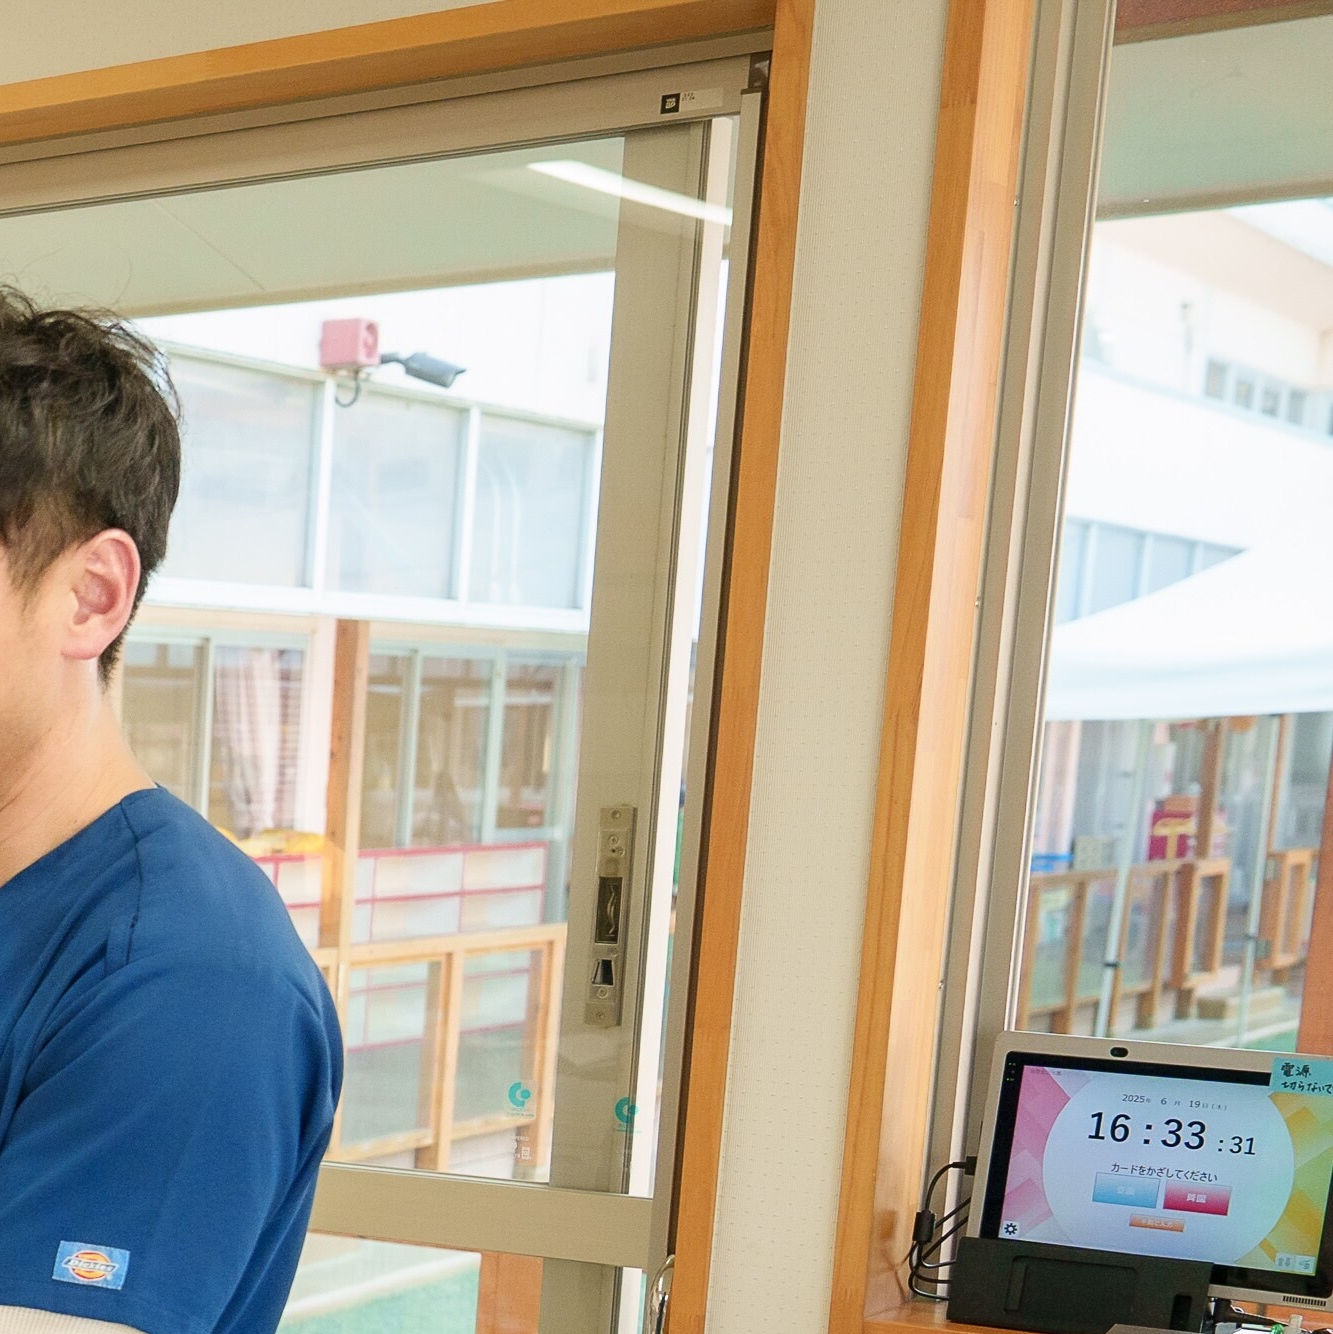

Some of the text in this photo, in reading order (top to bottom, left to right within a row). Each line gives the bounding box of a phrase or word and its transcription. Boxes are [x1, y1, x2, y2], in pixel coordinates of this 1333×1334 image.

[1280, 1062, 1311, 1078] 電源
[1122, 1093, 1152, 1104] 2025年
[1160, 1096, 1167, 1105] 6
[1111, 1162, 1218, 1183] カードをかざしてください
[68, 1258, 116, 1273] Dickies
